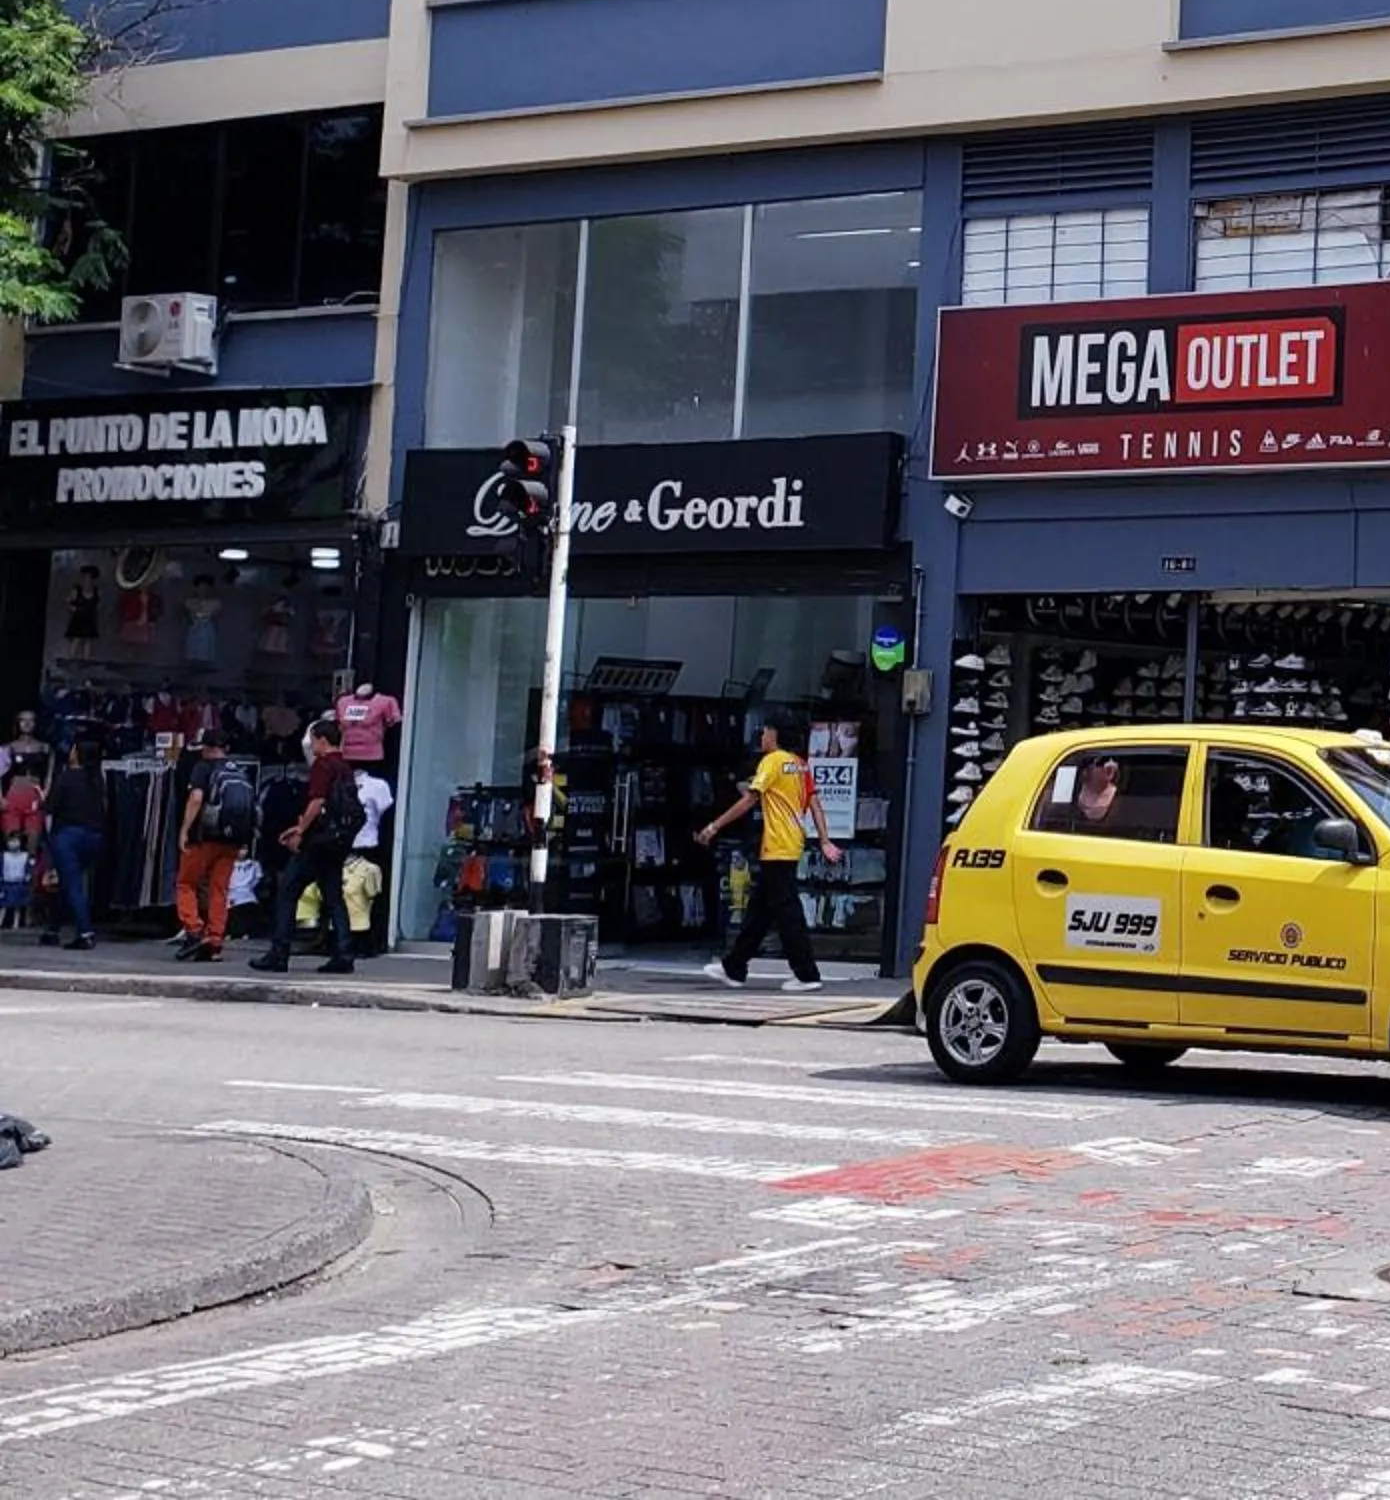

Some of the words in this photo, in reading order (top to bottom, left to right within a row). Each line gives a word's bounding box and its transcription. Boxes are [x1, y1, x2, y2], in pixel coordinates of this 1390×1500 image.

[1031, 329, 1171, 407] MEGA
[1187, 330, 1325, 389] OUTLET
[9, 420, 45, 456] EL
[48, 414, 144, 454] PUNTO
[147, 412, 189, 450] DE
[192, 410, 233, 449] LA
[237, 405, 328, 446] MODA
[1120, 429, 1242, 460] TENNIS
[56, 461, 266, 503] PROMOCIONES
[623, 499, 643, 522] &
[647, 476, 805, 531] Geordi
[1068, 909, 1111, 932] SJU
[1113, 913, 1157, 936] 999
[1227, 949, 1288, 965] SERVICIO
[1290, 953, 1347, 969] PUBLICO
